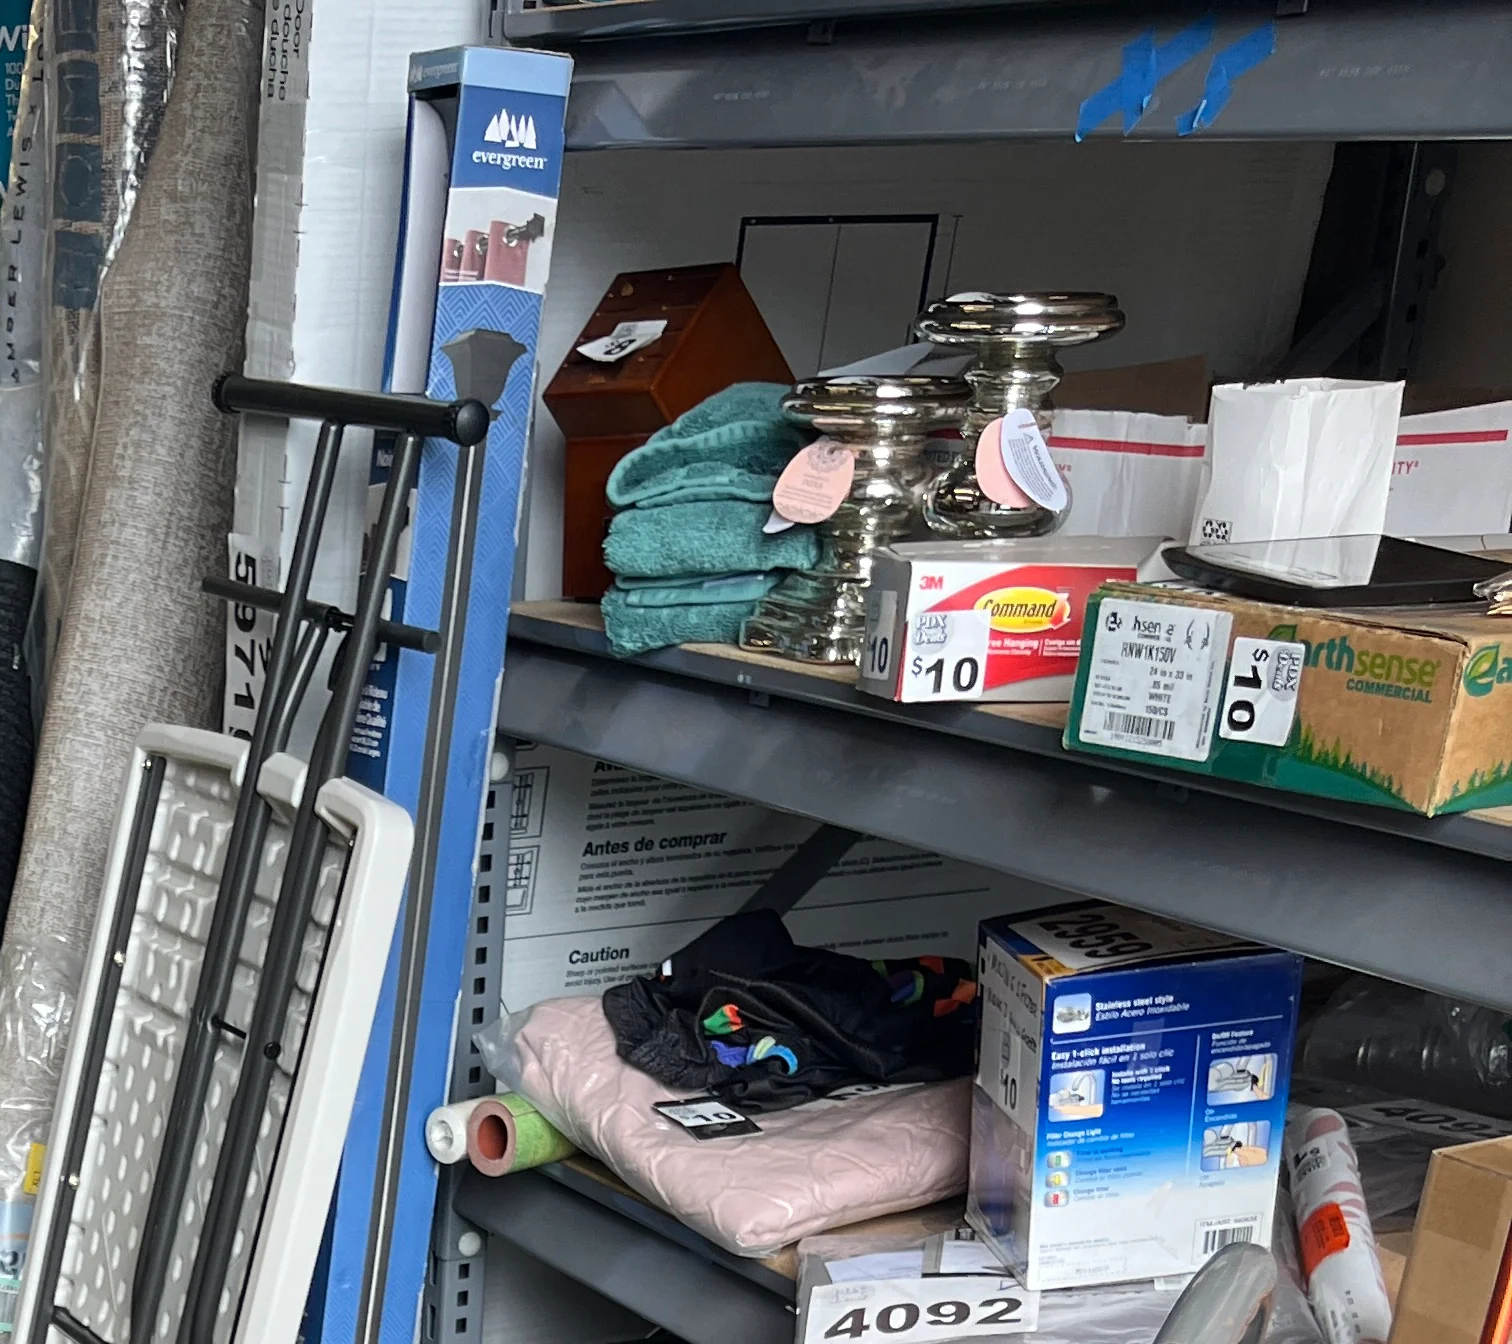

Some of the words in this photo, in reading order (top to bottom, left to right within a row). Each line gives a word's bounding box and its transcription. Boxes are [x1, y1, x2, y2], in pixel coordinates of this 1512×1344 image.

[471, 149, 545, 171] evergreen
[918, 575, 944, 591] 3M
[983, 599, 1057, 618] Command
[1283, 635, 1442, 688] arthsense
[1346, 678, 1433, 704] COMMERCIAL
[582, 839, 631, 857] Antes
[634, 836, 654, 852] de
[659, 831, 728, 850] comprar
[568, 947, 630, 965] Caution
[1095, 999, 1131, 1012] Stainless
[1133, 997, 1153, 1009] steel
[1155, 995, 1174, 1006] style
[1120, 1008, 1144, 1019] Acero
[1051, 1051, 1071, 1062] Easy
[1101, 1042, 1146, 1055] installation
[823, 1296, 1023, 1340] 4092
